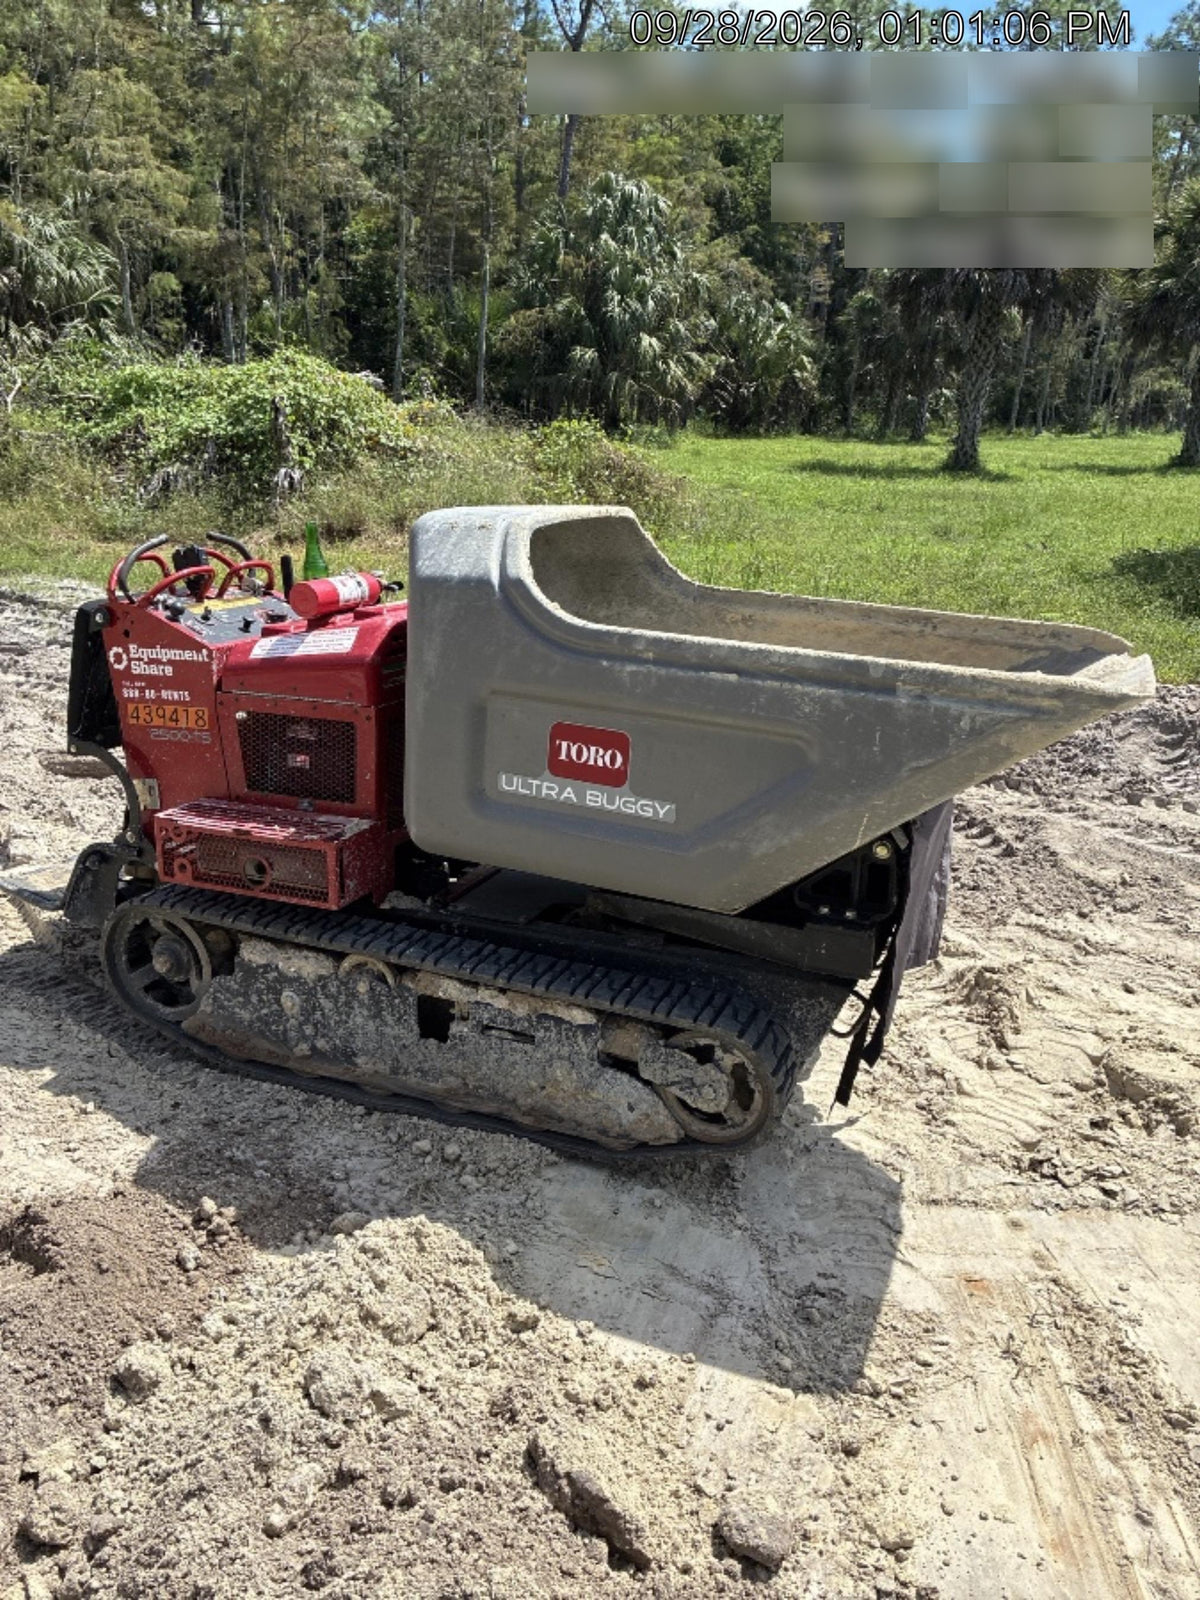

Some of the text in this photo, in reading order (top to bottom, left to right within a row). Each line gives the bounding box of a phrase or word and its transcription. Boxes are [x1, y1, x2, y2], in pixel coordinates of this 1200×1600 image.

[128, 644, 209, 663] Equipment
[131, 661, 173, 676] Share
[130, 705, 207, 728] 439418
[556, 739, 624, 769] TORO
[501, 774, 671, 819] ULTRA BUGGY
